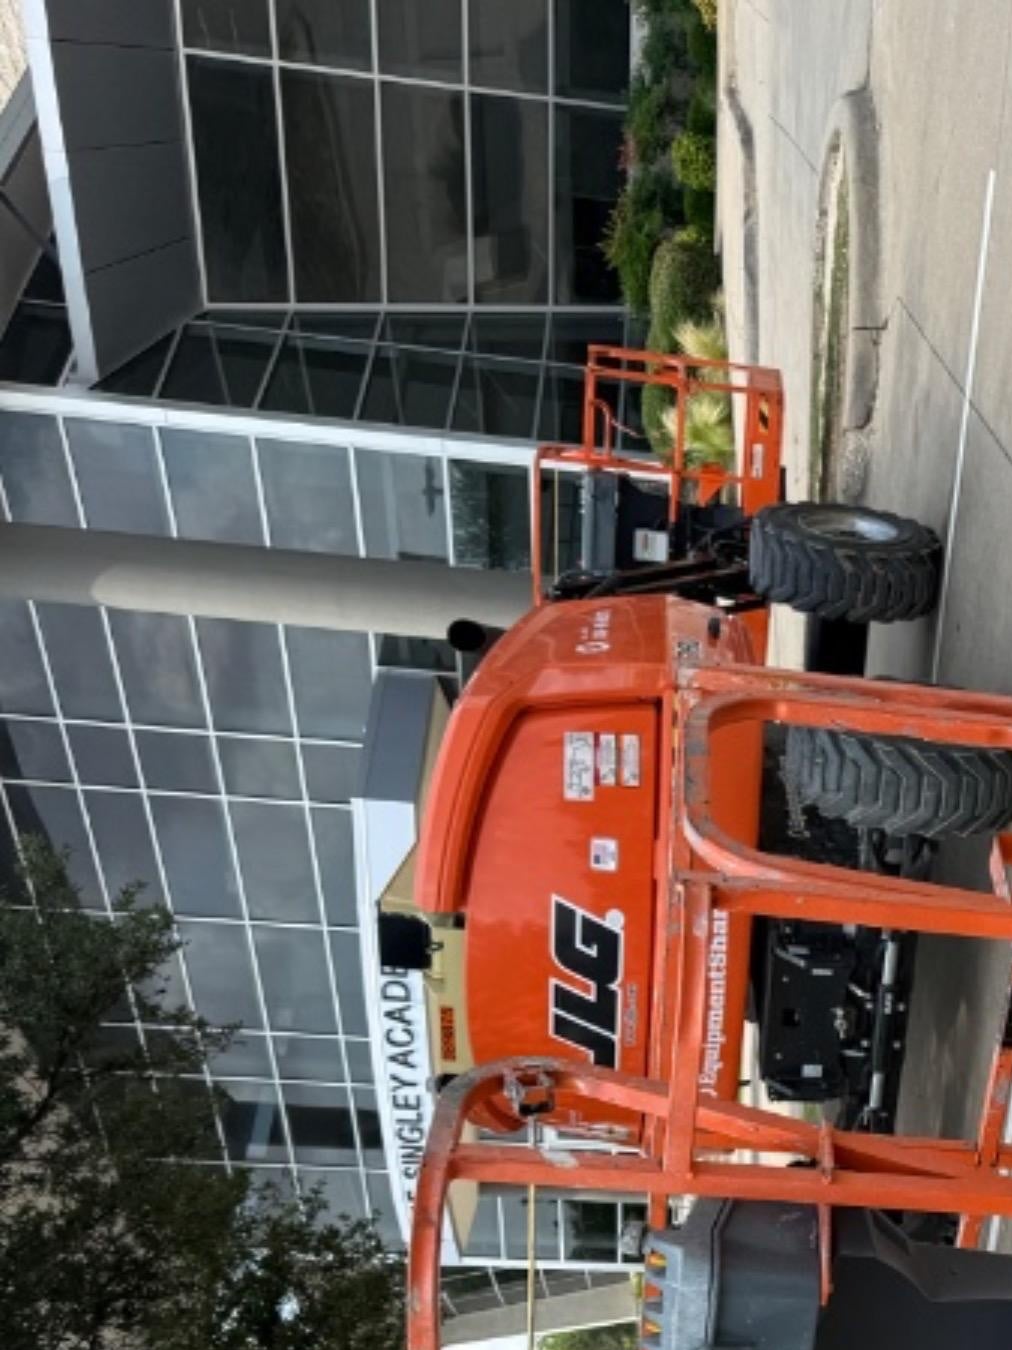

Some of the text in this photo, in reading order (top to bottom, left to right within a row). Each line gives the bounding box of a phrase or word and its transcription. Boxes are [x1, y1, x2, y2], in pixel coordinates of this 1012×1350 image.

[548, 894, 625, 1071] JLG
[698, 908, 728, 1085] EquipmentShar
[380, 966, 424, 1180] SINGLEY ACADE
